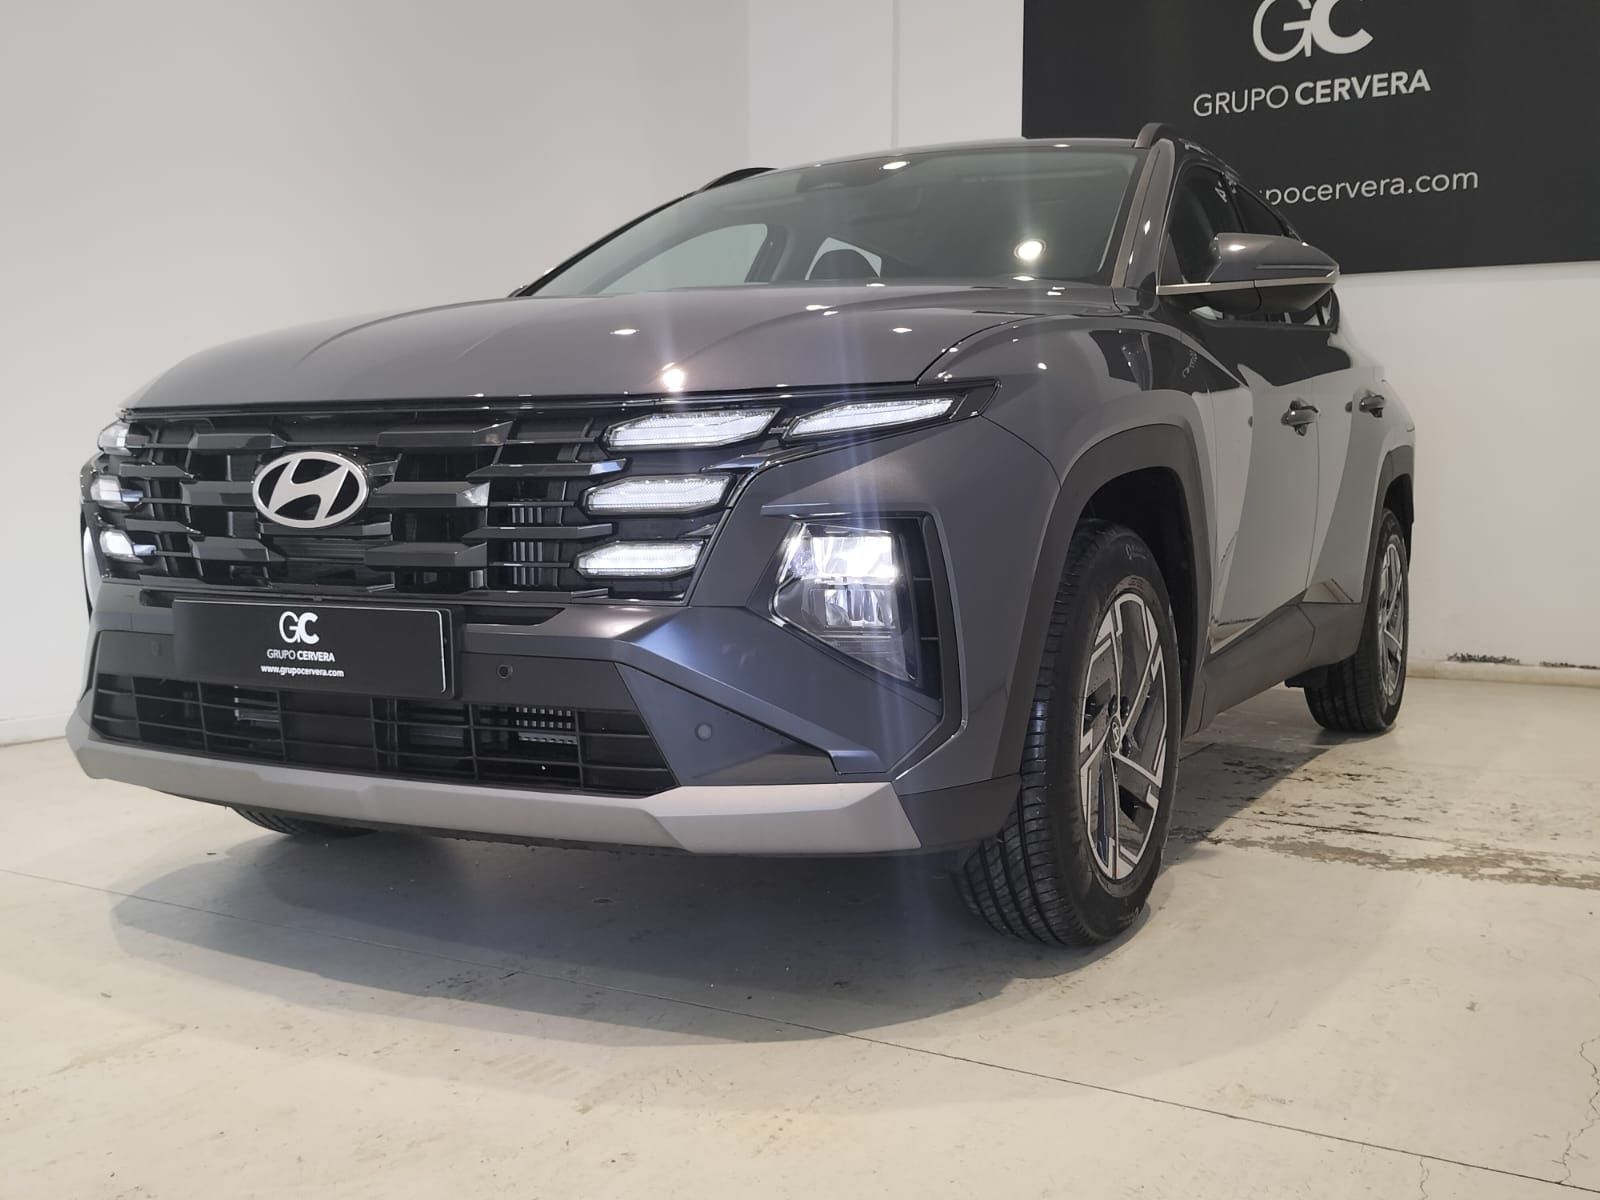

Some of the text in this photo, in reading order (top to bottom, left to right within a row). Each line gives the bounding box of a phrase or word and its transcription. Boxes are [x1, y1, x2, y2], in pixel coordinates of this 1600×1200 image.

[1193, 69, 1431, 117] GRUPO CERVERA
[1258, 171, 1479, 206] pocervera.com
[279, 611, 320, 645] GC
[260, 665, 345, 677] www.grupocervera.com
[266, 649, 336, 663] GRUPO CERVERA
